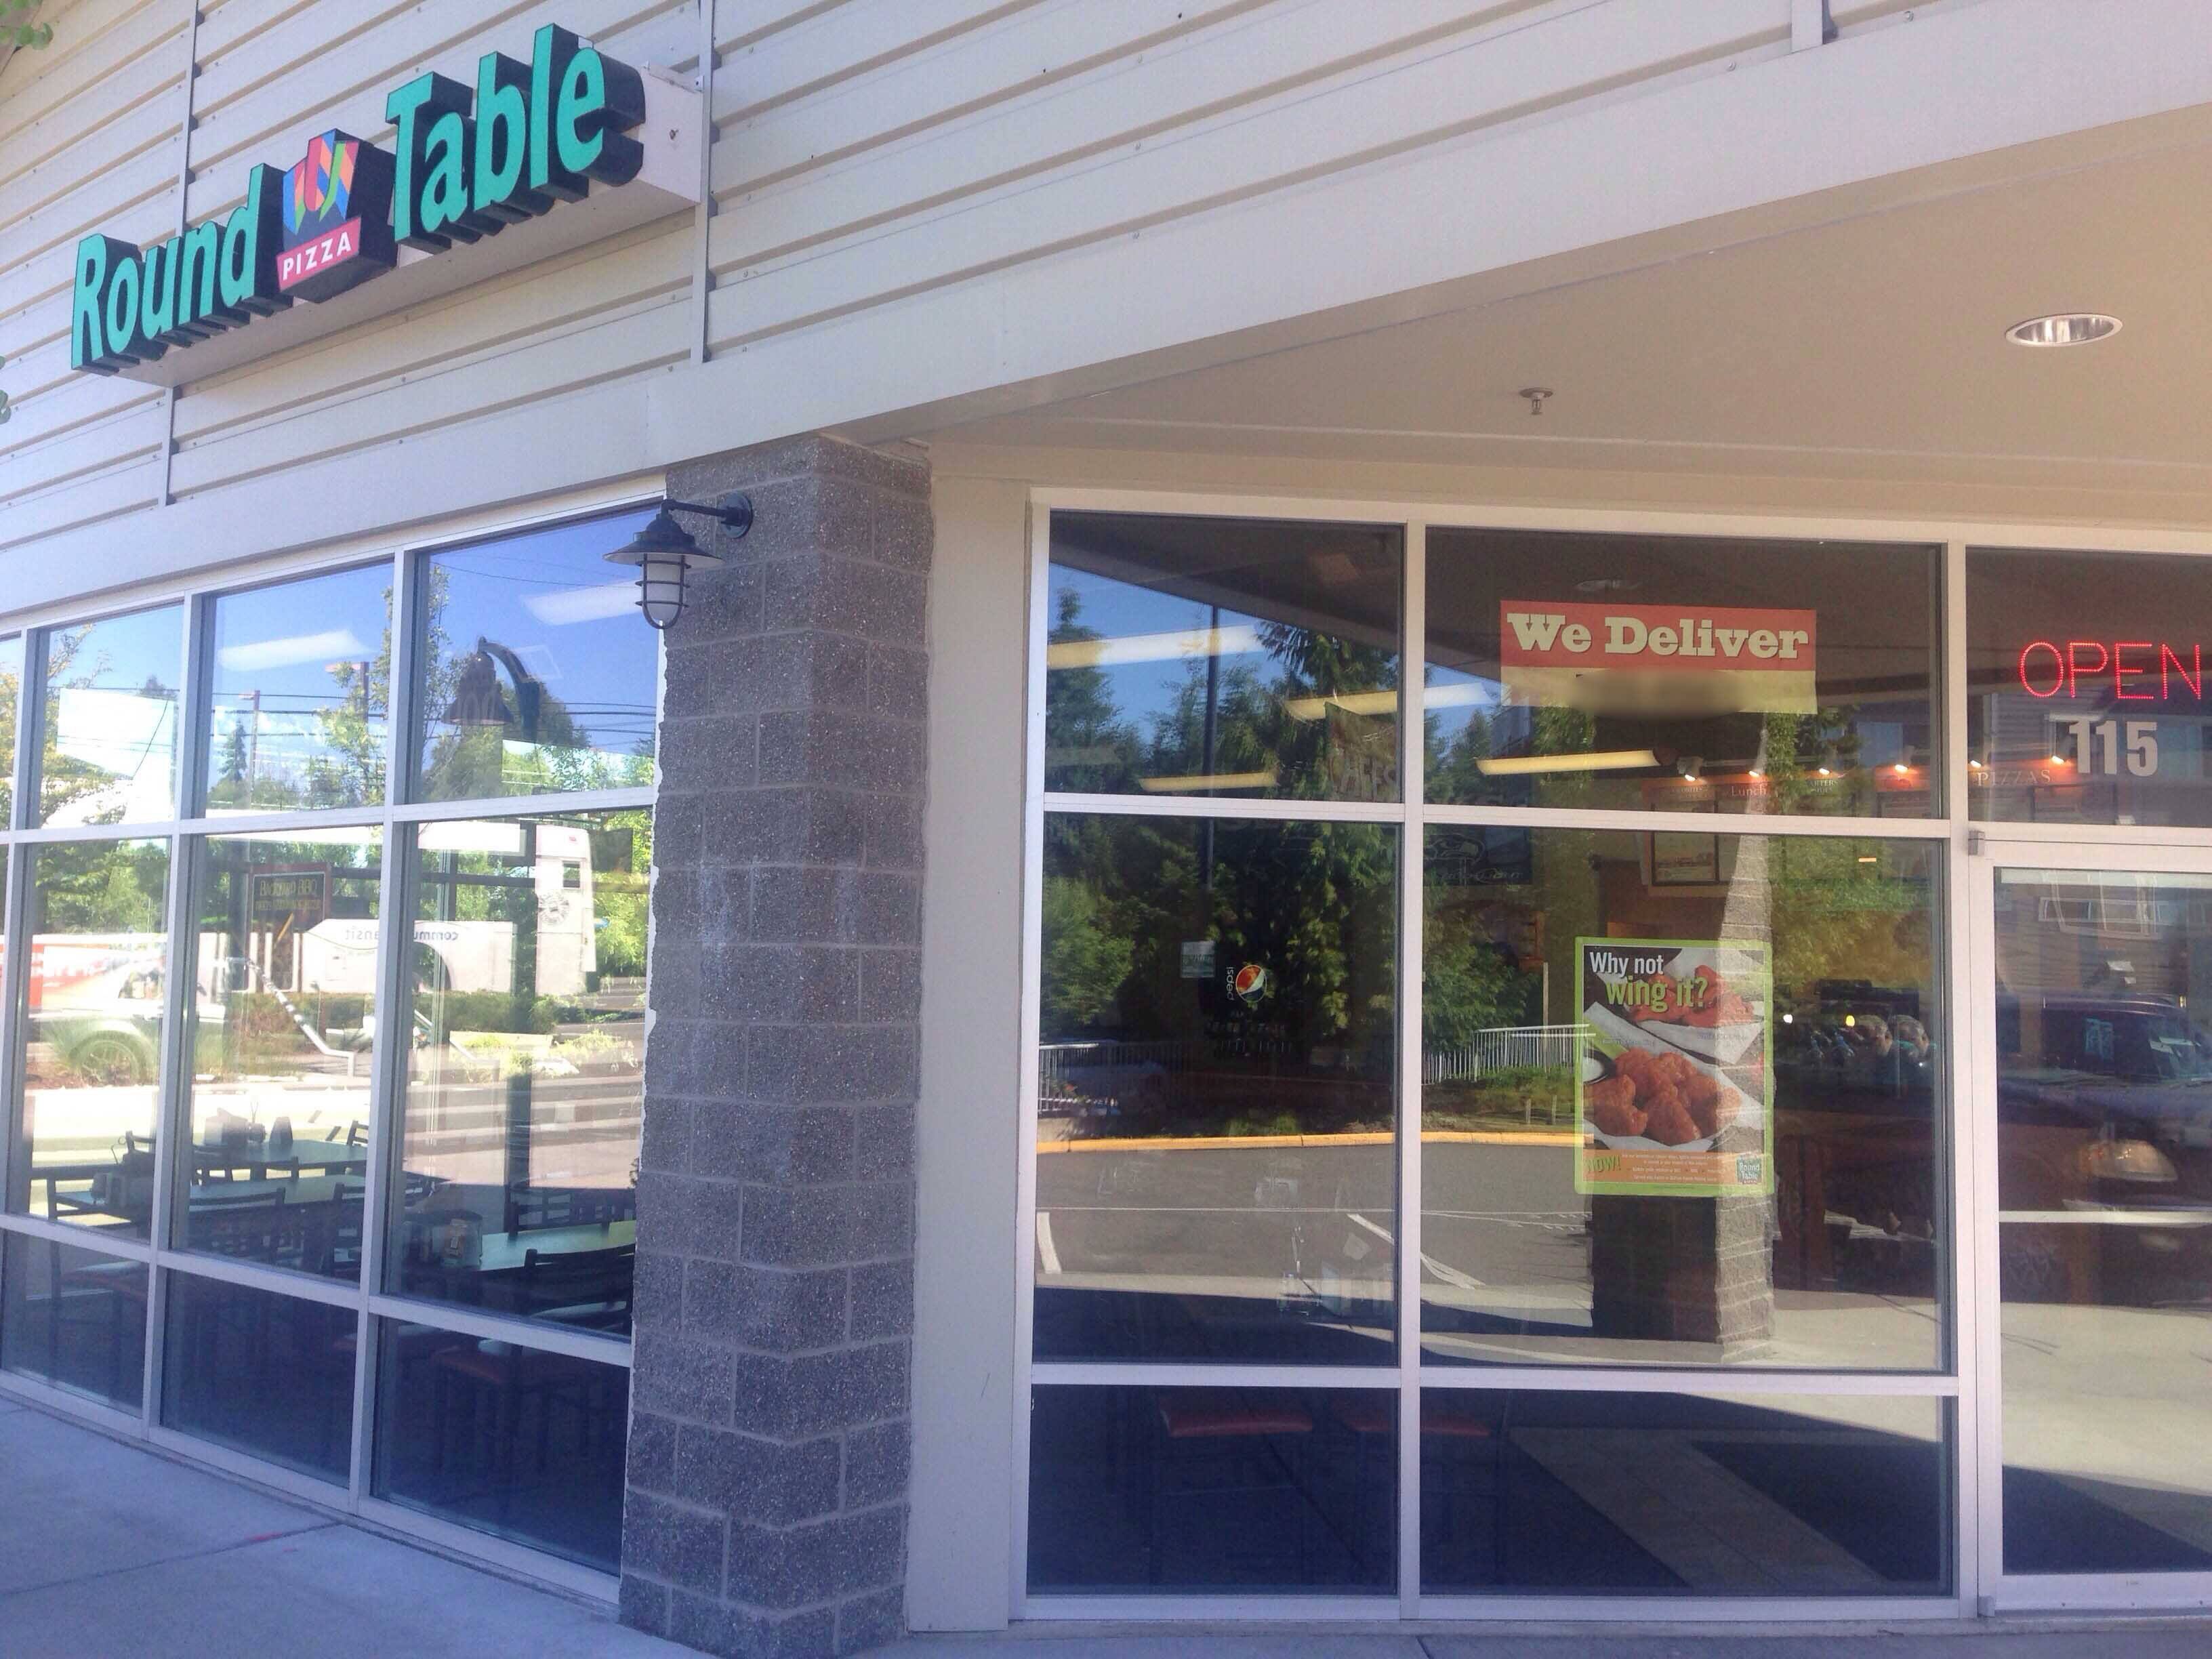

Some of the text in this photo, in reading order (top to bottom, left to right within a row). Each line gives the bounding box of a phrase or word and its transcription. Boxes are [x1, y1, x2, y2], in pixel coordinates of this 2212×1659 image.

[71, 23, 607, 370] Round Table
[281, 231, 352, 282] PIZZA
[1507, 613, 1809, 659] We Deliver
[2019, 641, 2202, 699] OPEN
[2069, 720, 2158, 777] 115
[1732, 783, 1767, 797] Lunch
[1978, 769, 2051, 787] PIZZAS
[1589, 951, 1664, 976] Why not
[1226, 967, 1235, 1001] pepsi
[1605, 976, 1708, 1013] wing it?
[1739, 1162, 1760, 1172] Round
[1741, 1171, 1758, 1180] Table
